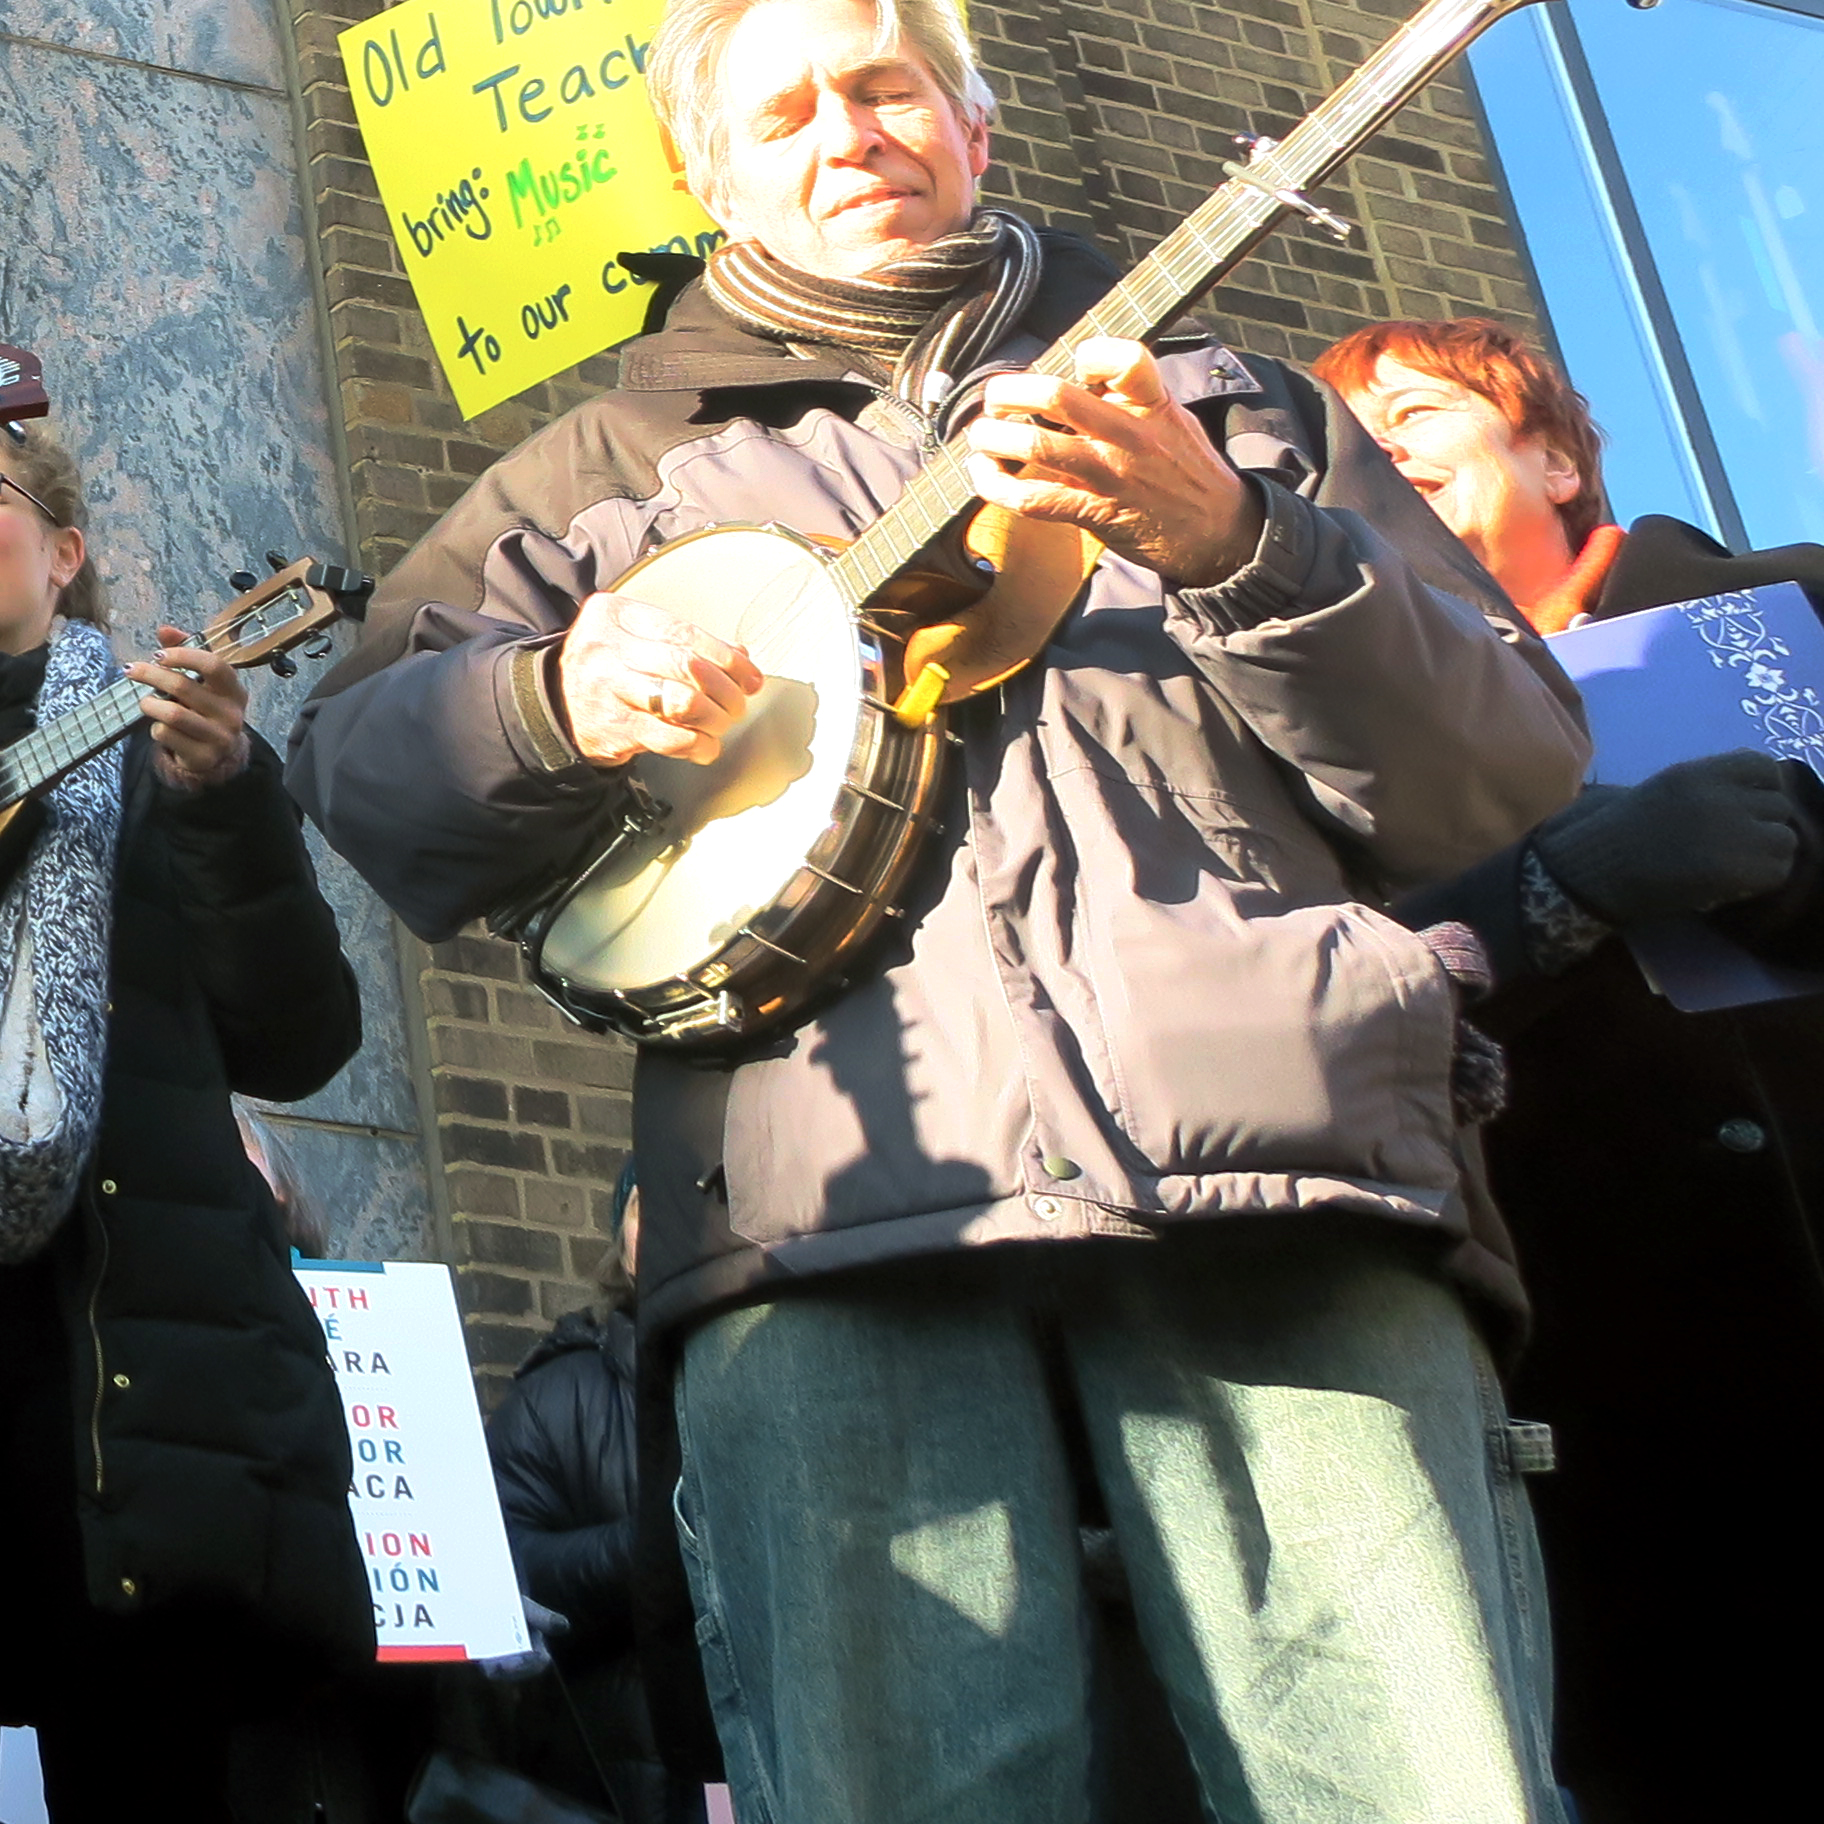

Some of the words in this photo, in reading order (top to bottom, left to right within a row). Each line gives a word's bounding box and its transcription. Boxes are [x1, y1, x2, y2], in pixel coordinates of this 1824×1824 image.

[362, 12, 448, 108] Old
[402, 166, 492, 258] bring:
[506, 148, 617, 230] Music
[456, 316, 502, 375] to
[521, 283, 572, 340] our
[352, 1404, 399, 1430] OR
[358, 1438, 406, 1465] OR
[365, 1532, 433, 1558] ION
[373, 1561, 440, 1593] IÓN
[373, 1603, 436, 1629] CJA
